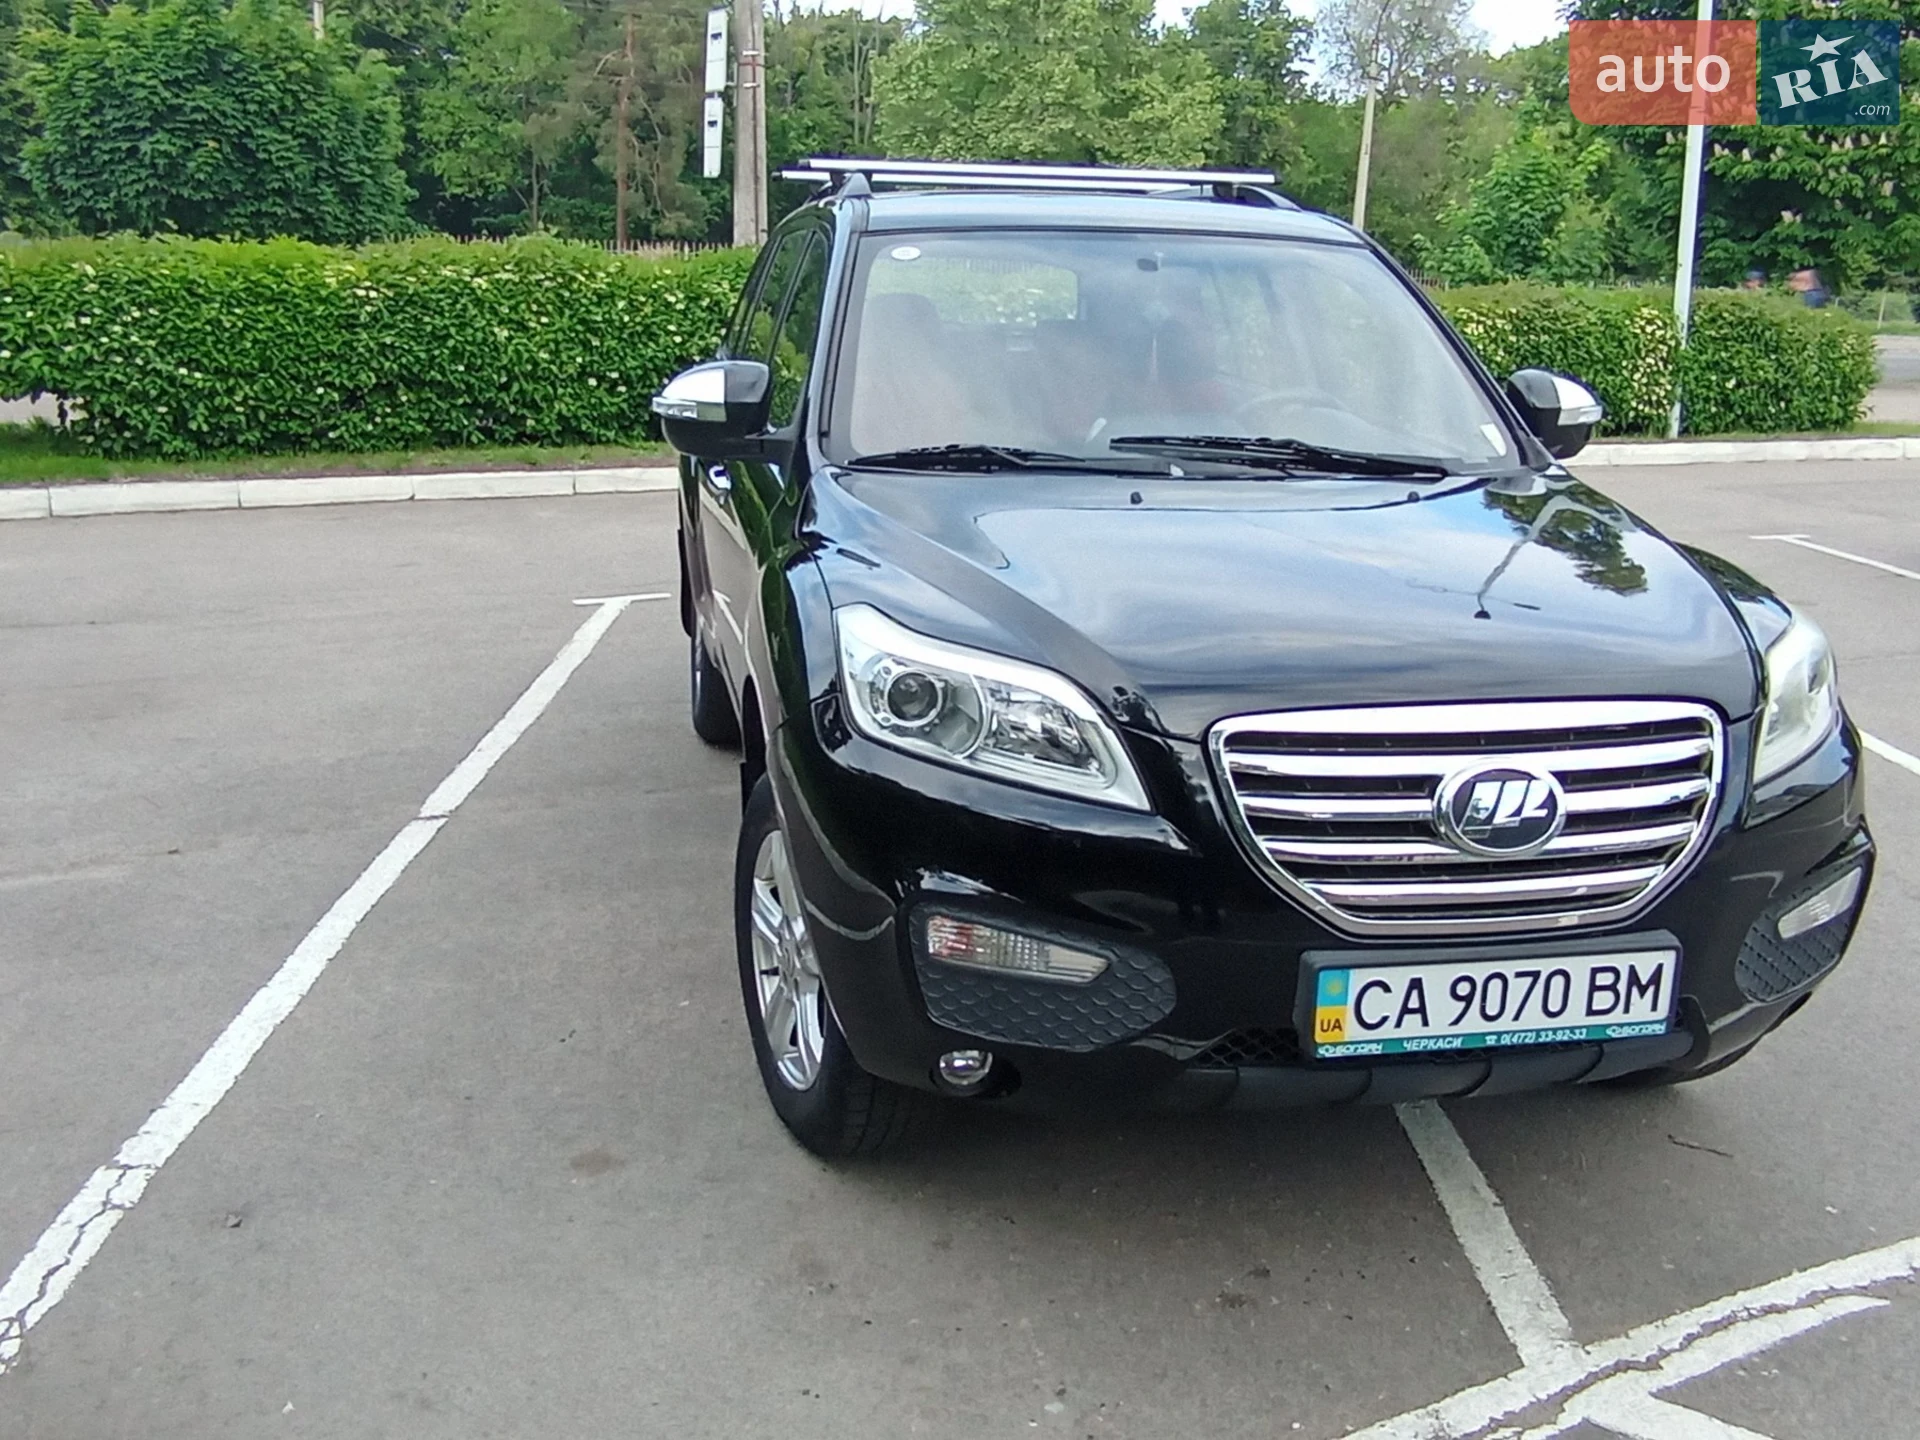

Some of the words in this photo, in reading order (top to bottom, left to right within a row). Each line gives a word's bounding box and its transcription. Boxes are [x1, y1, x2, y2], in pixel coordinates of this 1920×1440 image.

[1353, 976, 1430, 1031] CA
[1448, 967, 1573, 1027] 9070
[1584, 962, 1665, 1018] BM
[1319, 1018, 1343, 1034] UA
[1402, 1037, 1464, 1051] ЧЕРКАСИ
